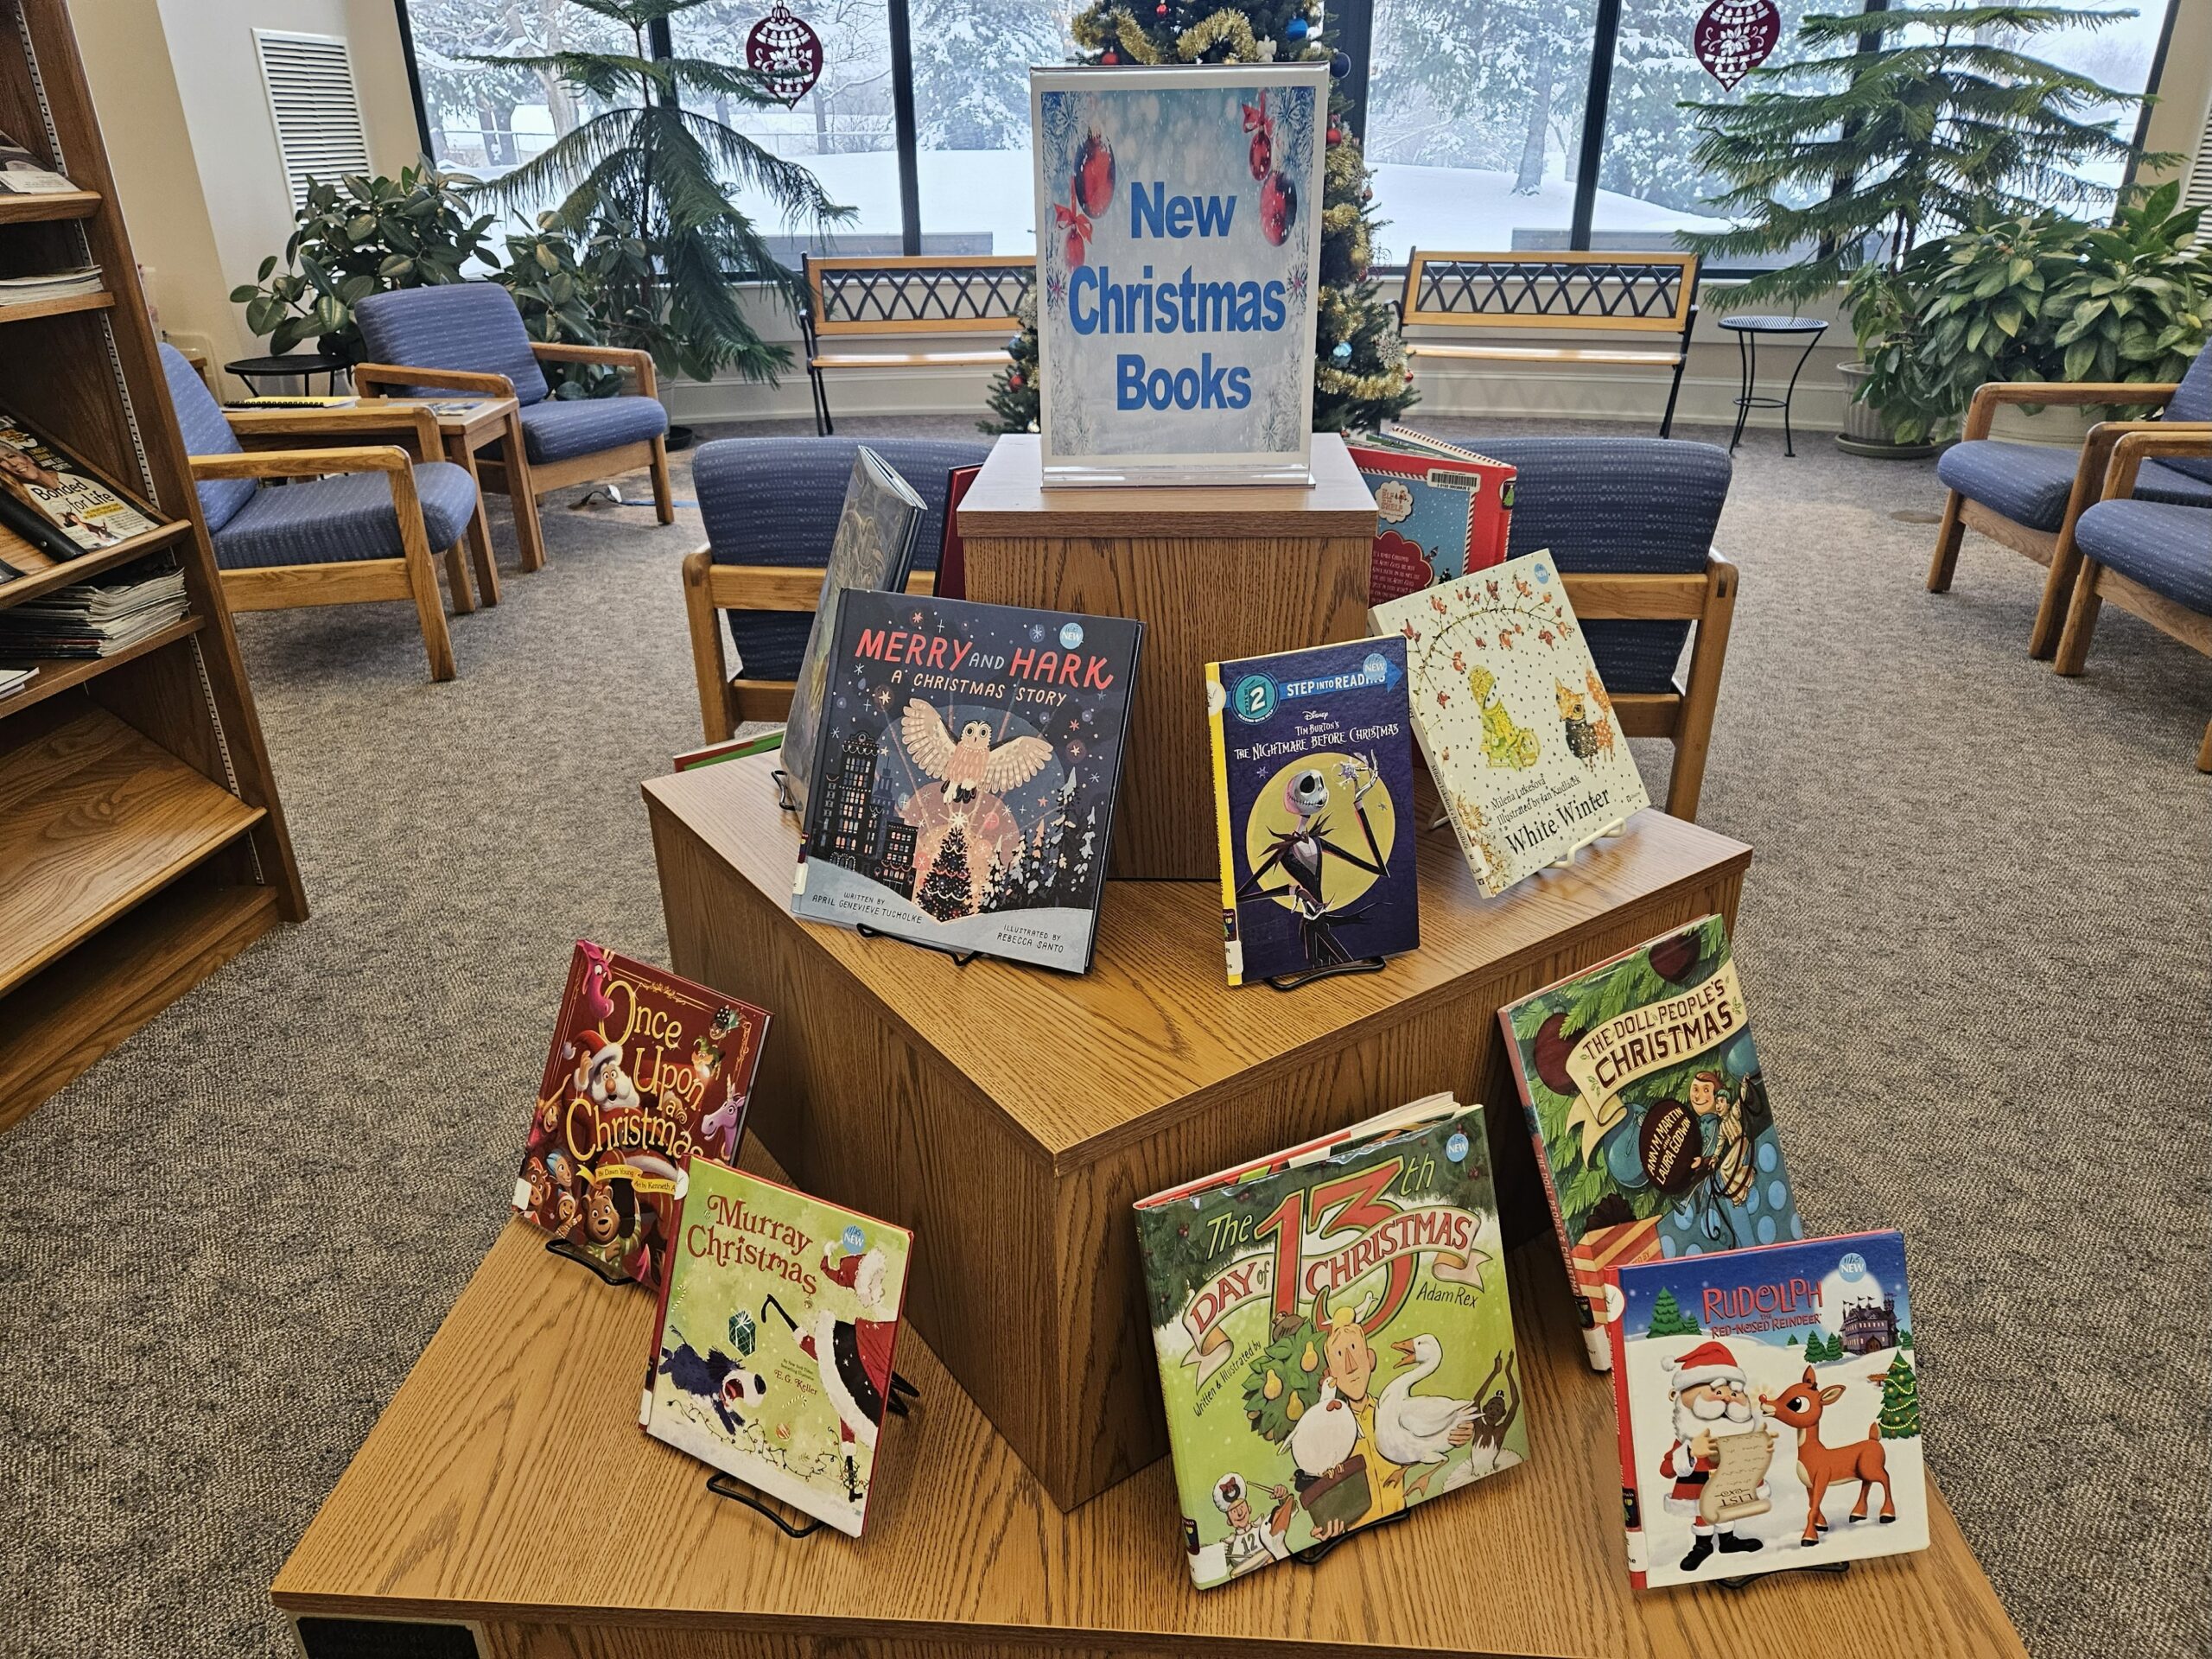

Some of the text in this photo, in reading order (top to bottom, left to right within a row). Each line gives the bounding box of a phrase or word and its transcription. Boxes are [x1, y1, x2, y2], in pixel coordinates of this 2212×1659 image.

[1130, 181, 1237, 239] New
[1068, 264, 1287, 336] Christmas
[1116, 353, 1252, 411] Books
[32, 478, 89, 501] Bonded
[66, 498, 88, 514] for
[81, 491, 114, 505] Life
[1061, 632, 1081, 641] NEW
[855, 628, 1114, 690] MERRY AND HARK
[1365, 663, 1384, 671] NEW
[891, 670, 1067, 708] A CHRISTMAS STORY
[1287, 672, 1386, 697] STEP INTO READ
[1249, 686, 1266, 712] 2
[1234, 723, 1399, 760] THE NIGHTMARE BEFORE CHRISTMAS
[1294, 721, 1340, 736] TIM BURTON'S
[1491, 791, 1516, 810] Milena
[1497, 800, 1532, 825] Illustrated
[1531, 798, 1541, 808] by
[1505, 788, 1610, 855] White Winter
[1456, 828, 1468, 849] Kudláče
[812, 894, 924, 925] APRIL GENEVIEVE TUCHOLKE
[843, 892, 874, 903] WRITTEN
[997, 932, 1064, 954] REBECCA SANTO
[1003, 924, 1048, 939] ILLUSTRATED
[599, 980, 683, 1048] Once
[1583, 978, 1725, 1059] THE DOLL PEOPLE'S
[1595, 1001, 1734, 1089] CHRISTMAS
[633, 1046, 705, 1111] Upon
[1448, 1144, 1466, 1154] NEW
[1647, 1146, 1659, 1176] ANN
[1656, 1107, 1684, 1139] MARTIN
[1656, 1117, 1691, 1185] LAURA GODWIN
[605, 1168, 618, 1177] Dawn
[619, 1168, 635, 1179] Young
[648, 1181, 670, 1192] Kenneth
[1536, 1154, 1546, 1172] THE
[1541, 1173, 1553, 1198] DOLL
[708, 1195, 813, 1255] Murray
[1206, 1211, 1253, 1260] The
[844, 1232, 863, 1247] NEW
[687, 1224, 817, 1294] Christmas
[1840, 1263, 1865, 1273] NEW
[1190, 1213, 1471, 1334] DAY of CHRISTMAS
[1416, 1281, 1479, 1308] Adam Rex
[1703, 1278, 1823, 1324] RUDOLPH
[1712, 1314, 1821, 1339] RED-NOSED REINDEER
[774, 1369, 817, 1395] E. G. Keller
[1192, 1339, 1262, 1417] Written & Illustrated by
[1721, 1492, 1753, 1507] LIST
[1241, 1533, 1258, 1555] 12
